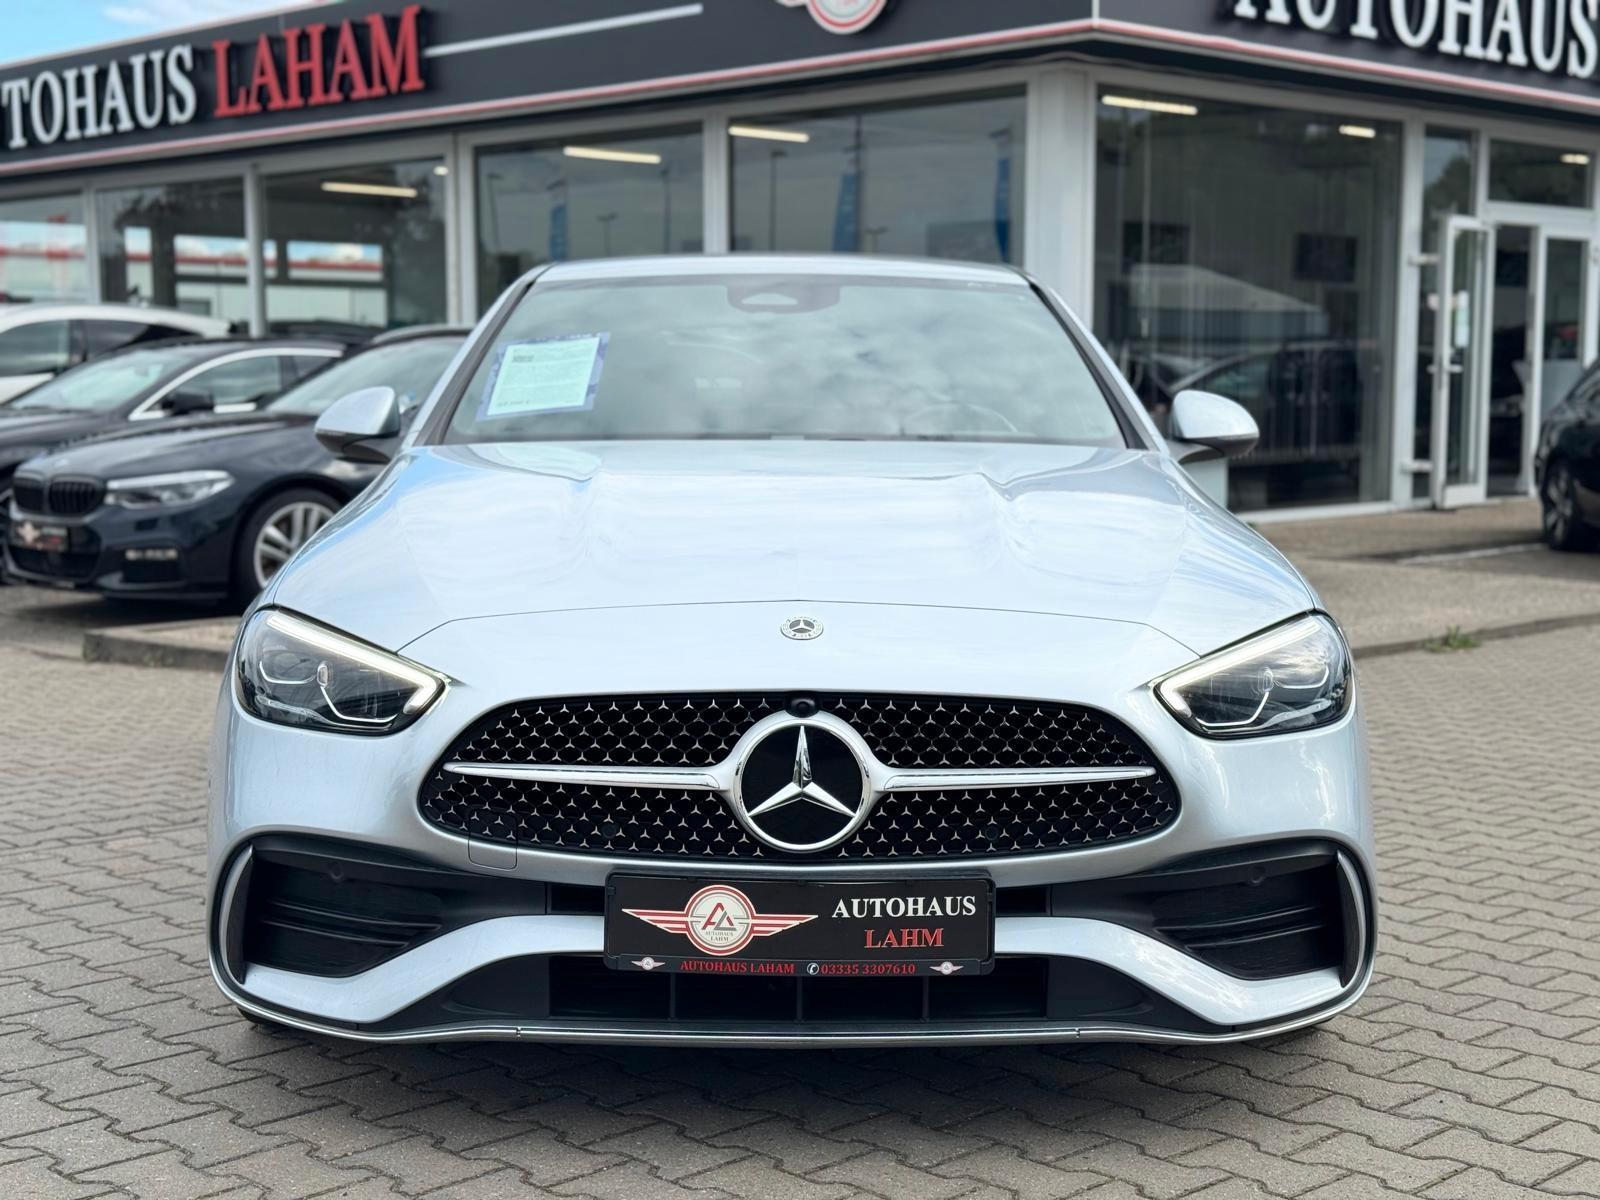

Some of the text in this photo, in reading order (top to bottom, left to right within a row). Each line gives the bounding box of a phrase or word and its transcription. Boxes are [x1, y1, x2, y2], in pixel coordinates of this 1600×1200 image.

[1, 4, 425, 149] TOHAUS LAHAM
[832, 896, 976, 918] AUTOHAUS
[864, 928, 944, 948] LAHM
[680, 960, 795, 974] AUTOHAUS LAHAM
[820, 963, 916, 975] 03335 3307610
